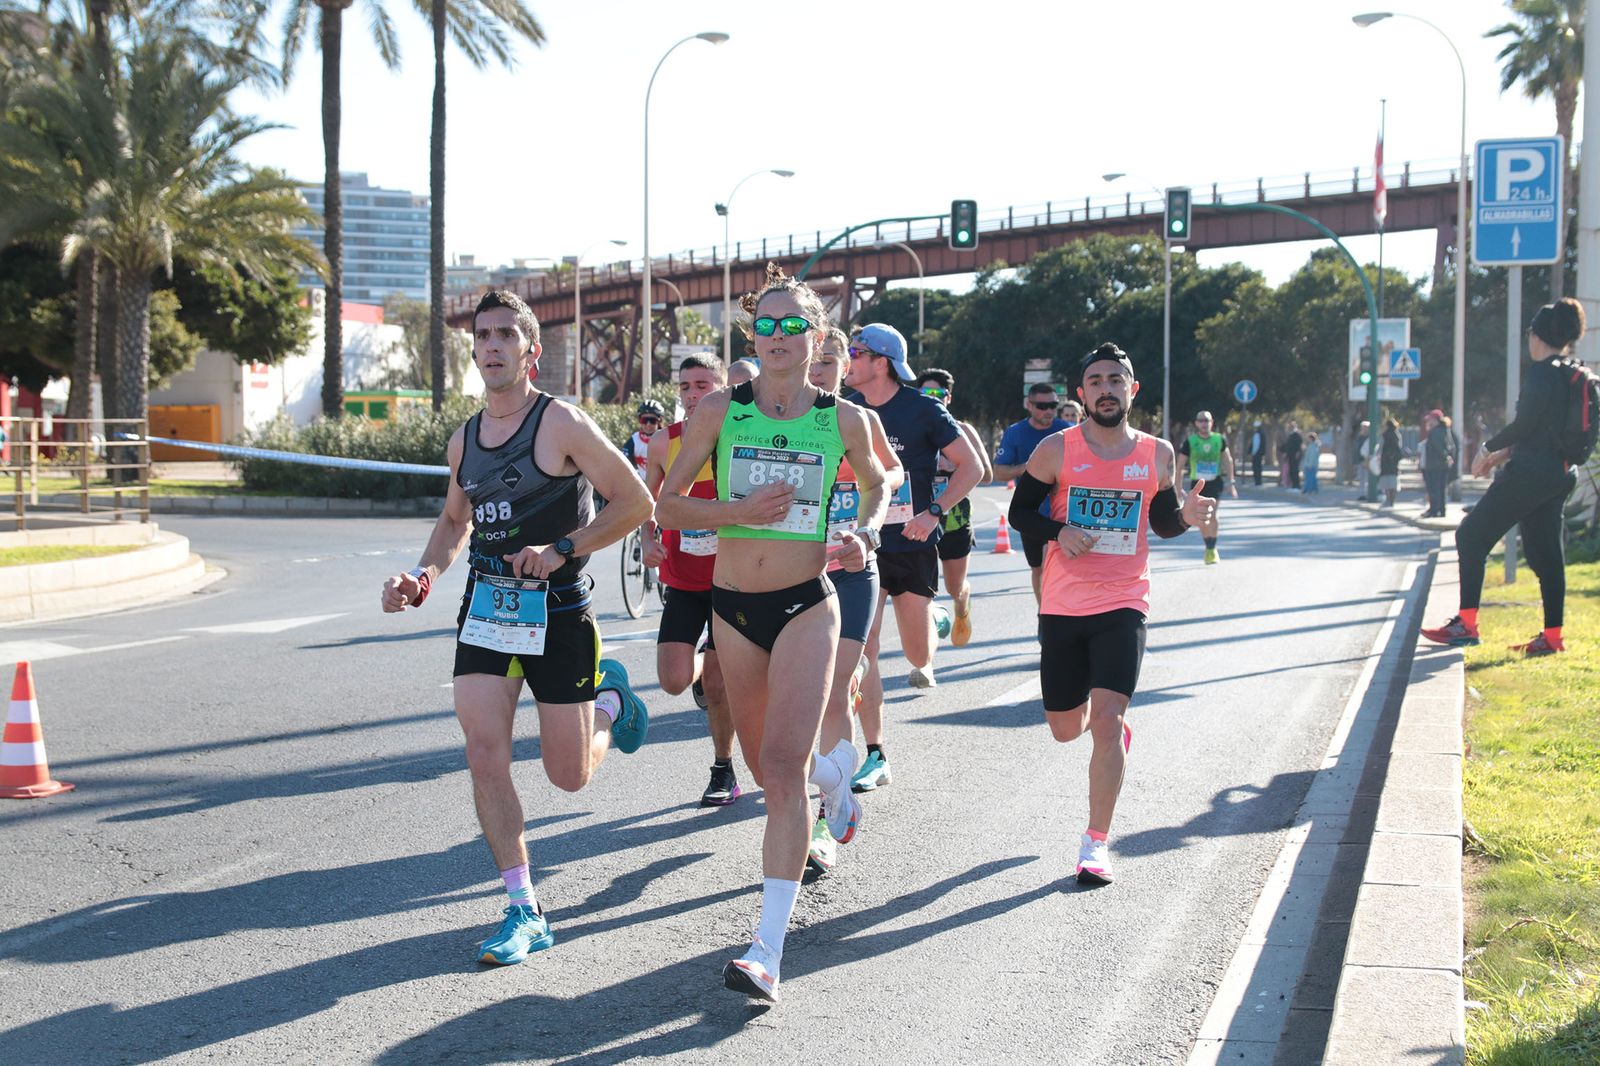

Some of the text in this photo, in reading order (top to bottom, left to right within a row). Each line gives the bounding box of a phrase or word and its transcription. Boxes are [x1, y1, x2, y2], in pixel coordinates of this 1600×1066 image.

[1496, 148, 1545, 201] P
[1511, 187, 1531, 200] 24
[748, 461, 805, 489] 858
[1076, 498, 1135, 520] 1037
[486, 530, 507, 541] OCR
[491, 588, 521, 612] 93
